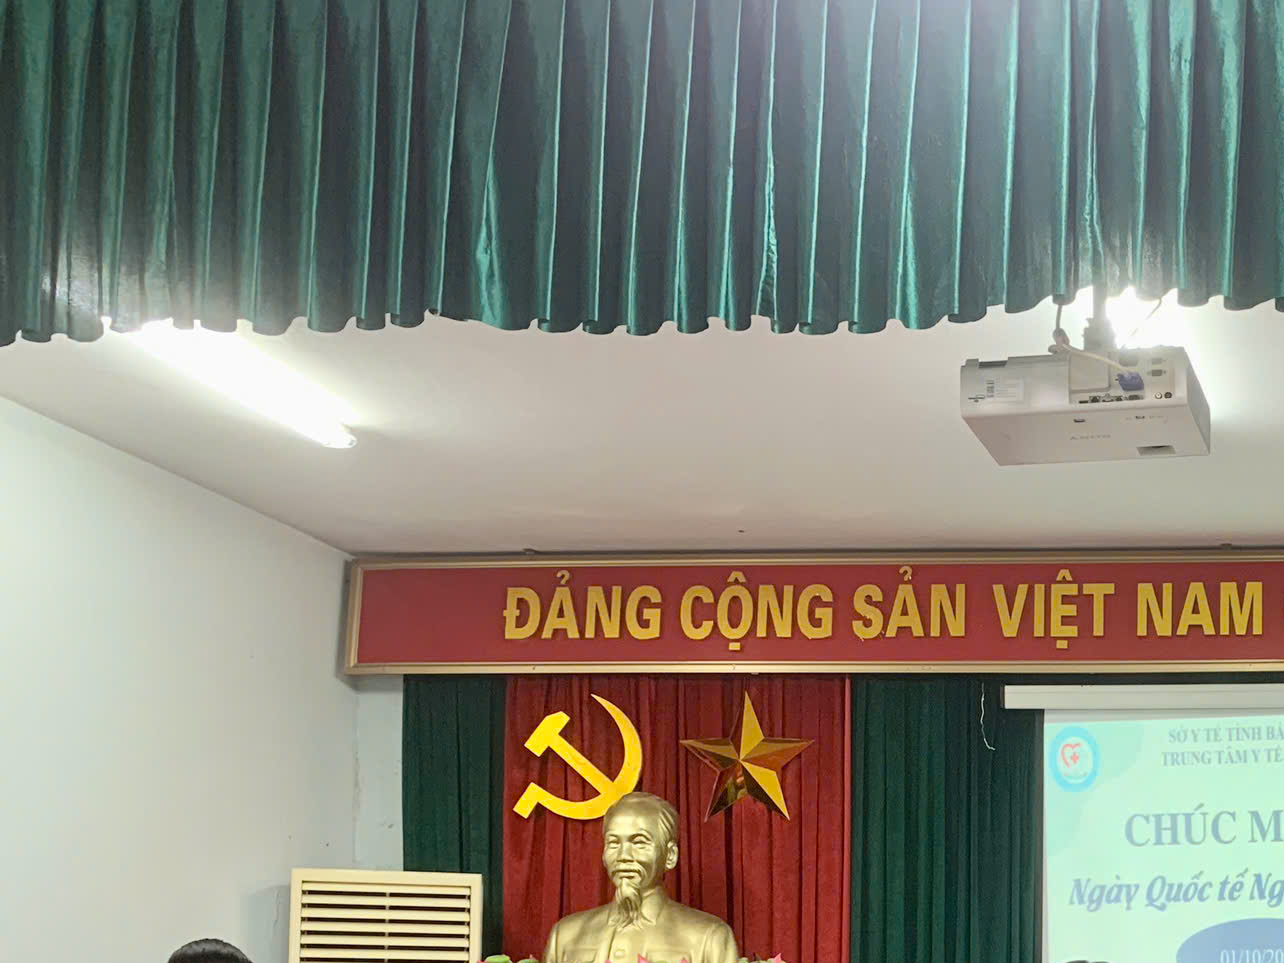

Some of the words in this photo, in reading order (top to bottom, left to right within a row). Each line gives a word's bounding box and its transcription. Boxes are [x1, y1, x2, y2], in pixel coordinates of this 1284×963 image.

[503, 569, 662, 641] ĐẢNG
[679, 571, 833, 651] CỘNG
[851, 565, 966, 640] SẢN
[993, 569, 1115, 649] VIỆT
[1137, 580, 1264, 638] NAM
[1161, 750, 1212, 767] TRUNG
[1215, 746, 1249, 765] TÂM
[1250, 749, 1262, 764] Y
[1263, 745, 1284, 763] TẾ
[1190, 728, 1201, 743] Y
[1203, 724, 1223, 743] TẾ
[1124, 803, 1238, 848] CHÚC
[1069, 874, 1140, 913] Ngày
[1145, 871, 1213, 912] Quốc
[1217, 867, 1249, 902] tế
